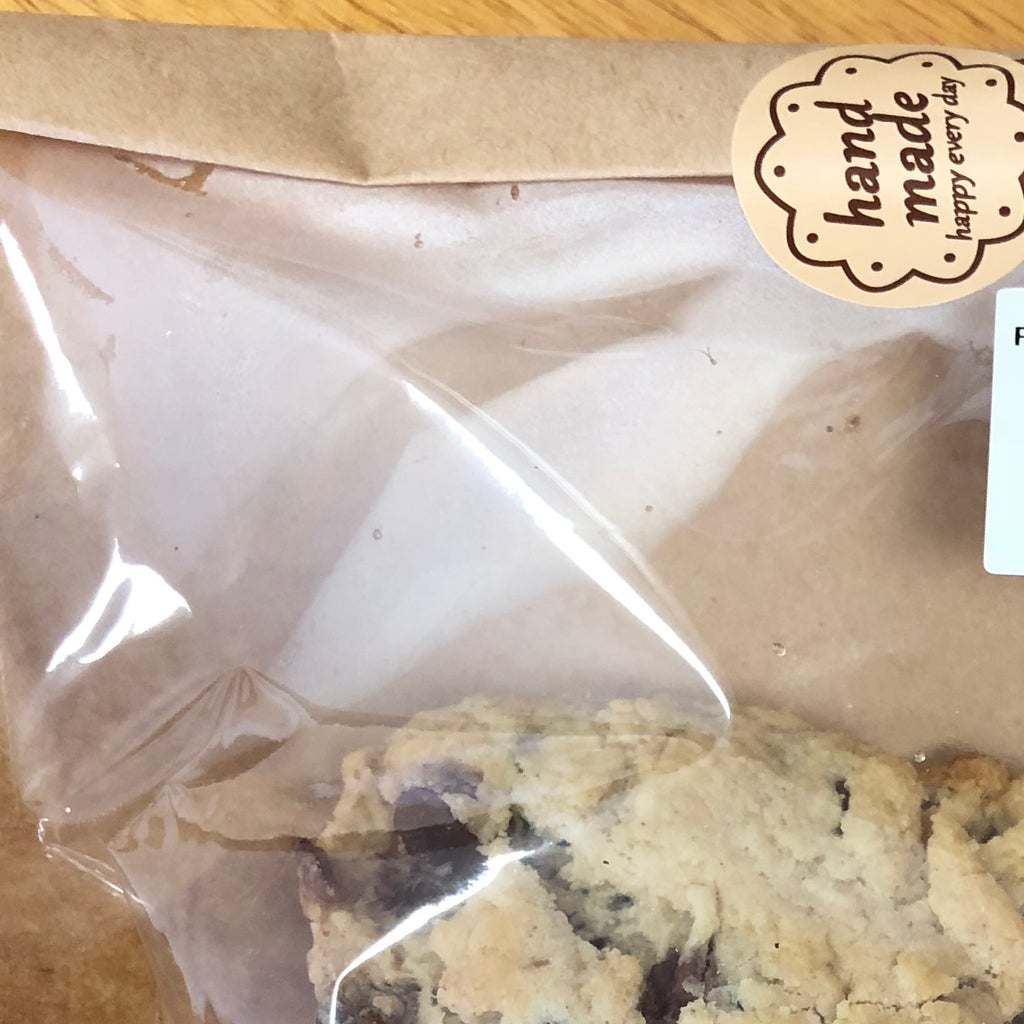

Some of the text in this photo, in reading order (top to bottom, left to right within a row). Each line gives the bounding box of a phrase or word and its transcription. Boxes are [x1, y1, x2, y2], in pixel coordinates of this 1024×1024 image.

[813, 99, 886, 227] hand
[872, 91, 940, 228] made
[932, 76, 978, 240] happy every day
